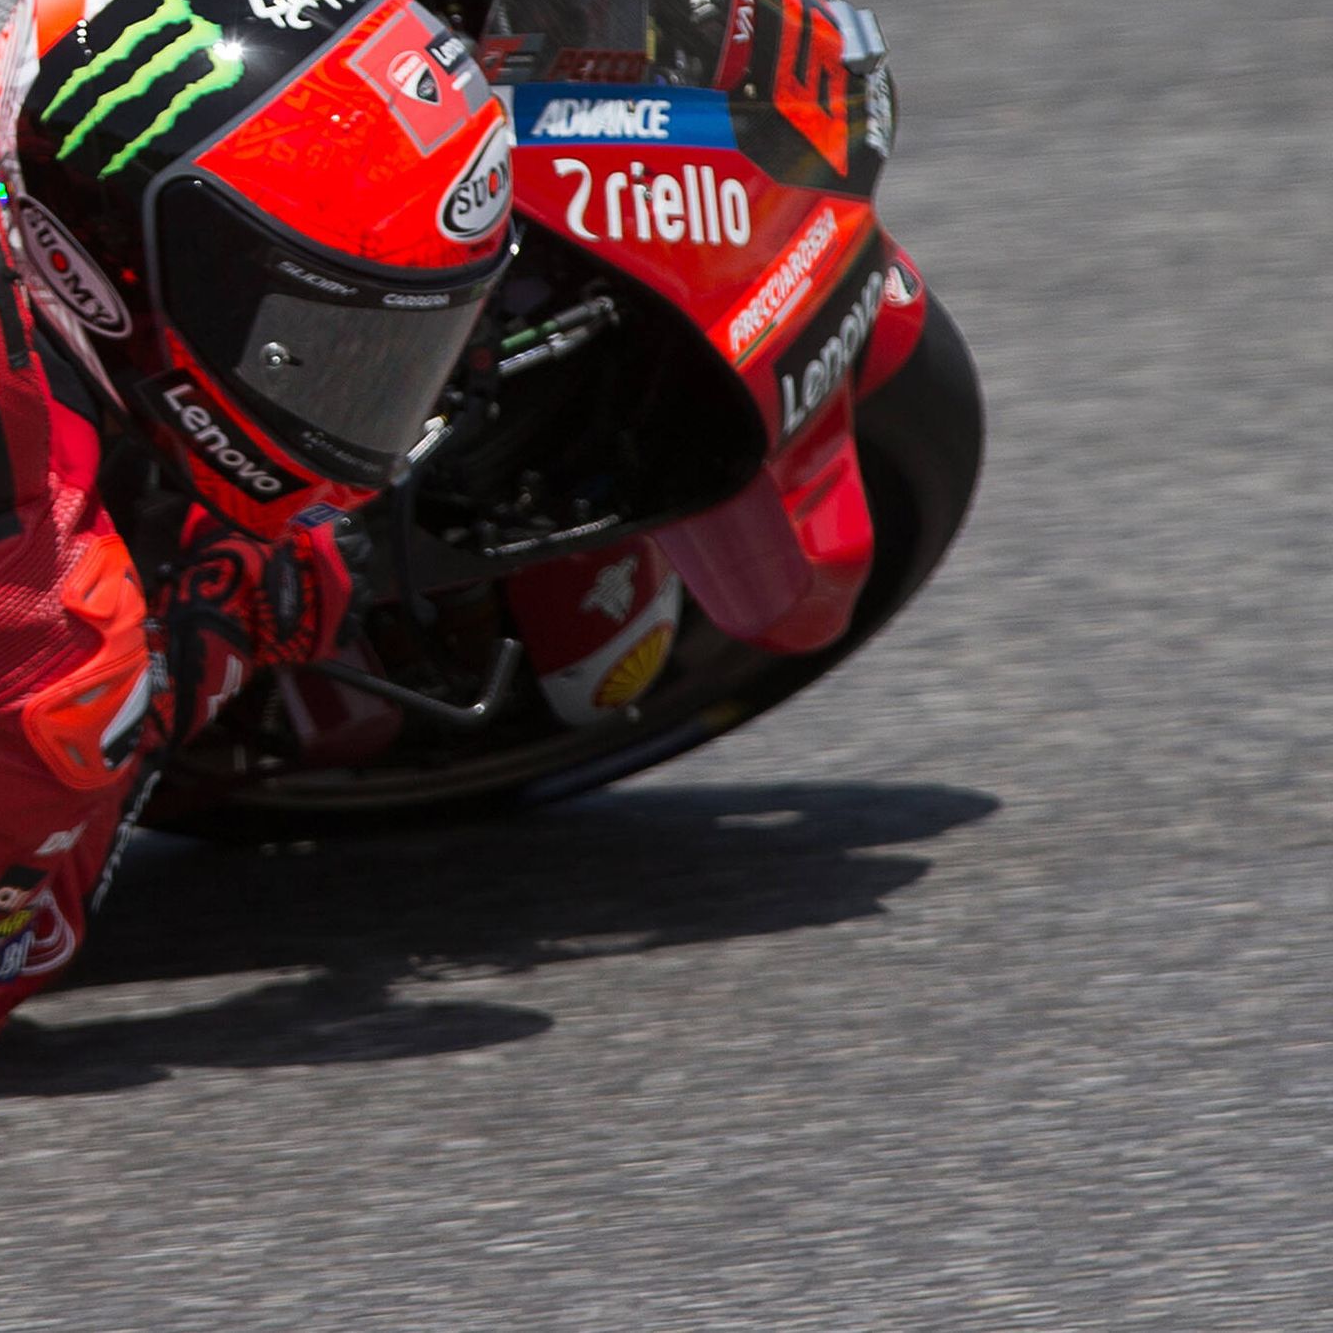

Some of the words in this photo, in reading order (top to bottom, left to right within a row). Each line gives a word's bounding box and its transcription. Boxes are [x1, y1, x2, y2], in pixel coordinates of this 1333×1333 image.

[532, 97, 673, 140] ADVANCE
[605, 161, 751, 247] riello
[781, 271, 885, 437] Lenovo
[160, 381, 283, 499] Lenovo
